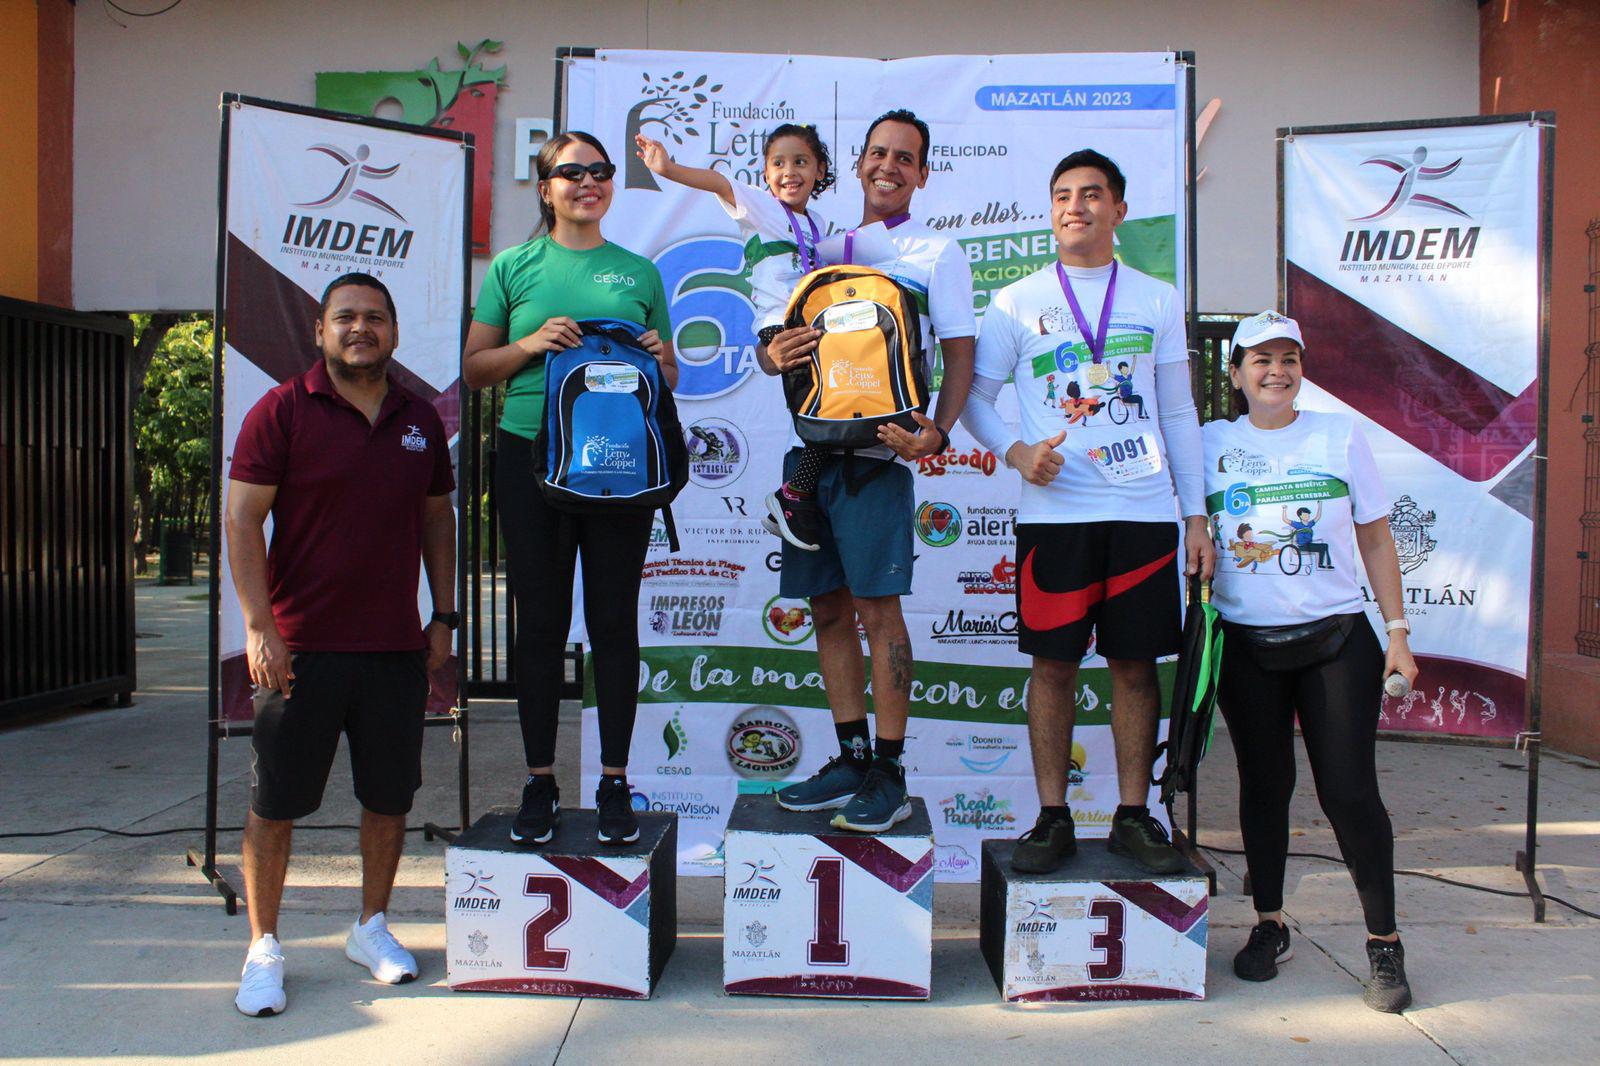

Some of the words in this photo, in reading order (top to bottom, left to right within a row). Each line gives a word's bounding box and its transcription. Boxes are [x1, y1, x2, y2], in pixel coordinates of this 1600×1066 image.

[990, 90, 1088, 107] MAZATLÁN
[1091, 91, 1132, 107] 2023
[712, 100, 795, 120] Fundación
[932, 145, 1008, 157] FELICIDAD
[282, 213, 414, 259] IMDEM
[1339, 225, 1481, 262] IMDEM
[280, 246, 317, 258] INSTITUTO
[318, 251, 358, 264] MUNICIPAL
[359, 257, 372, 266] DEL
[373, 258, 405, 269] DEPORTE
[1338, 263, 1377, 271] INSTITUTO
[1378, 262, 1419, 270] MUNICIPAL
[1421, 261, 1435, 270] DEL
[1436, 260, 1472, 270] DEPORTE
[593, 273, 636, 287] CESAD
[1055, 341, 1079, 374] 6
[401, 434, 427, 448] IMDEM
[604, 459, 636, 470] Coppel
[1240, 466, 1272, 476] Coppel
[1254, 483, 1293, 494] CAMINATA
[1294, 480, 1328, 489] BENÉFICA
[1224, 482, 1251, 517] 6
[1256, 493, 1295, 504] PARÁLISIS
[1295, 491, 1332, 501] CEREBRAL
[967, 506, 1007, 515] fundación
[684, 527, 725, 536] VICTOR
[729, 527, 744, 536] DE
[642, 559, 669, 570] ontrol
[706, 559, 717, 567] de
[718, 560, 746, 572] Plagas
[690, 568, 706, 576] S.A.
[721, 570, 738, 580] C.V.
[956, 571, 992, 583] AUTO
[650, 595, 726, 611] IMPRESOS
[672, 609, 723, 631] LEÓN
[690, 654, 741, 692] la
[910, 679, 987, 709] con
[731, 720, 799, 740] ABARROTES
[971, 735, 1003, 744] ODONTO
[656, 766, 692, 776] CESAD
[651, 791, 703, 802] INSTITUTO
[955, 793, 996, 812] Real
[732, 887, 782, 900] IMDEM
[454, 896, 501, 910] IMDEM
[806, 856, 850, 967] 1
[523, 873, 572, 973] 2
[1016, 922, 1057, 933] IMDEM
[1086, 898, 1127, 982] 3
[732, 949, 781, 958] MAZATLÁN
[455, 958, 503, 968] MAZATLÁN
[1014, 974, 1056, 982] MAZATLÁN
